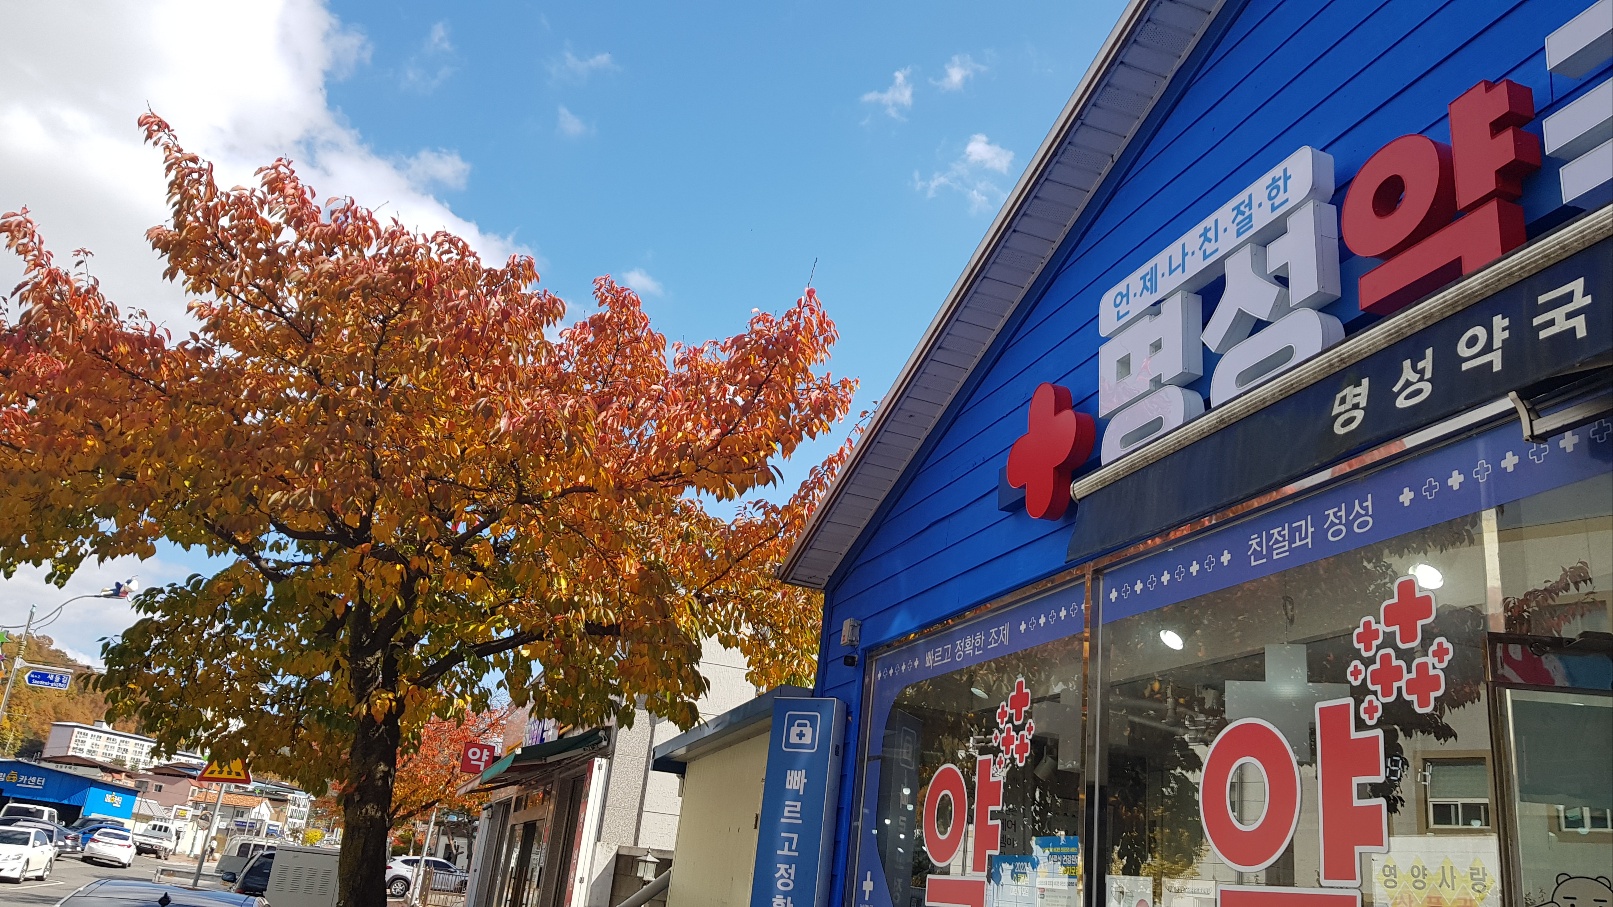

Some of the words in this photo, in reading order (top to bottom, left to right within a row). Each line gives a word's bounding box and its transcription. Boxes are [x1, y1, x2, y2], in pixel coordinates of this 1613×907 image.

[1247, 514, 1315, 567] 친절과
[1323, 493, 1373, 542] 정성
[924, 644, 951, 669] 빠르고
[954, 630, 985, 662] 정확한
[987, 622, 1010, 649] 조제
[467, 747, 490, 771] 약
[17, 775, 46, 786] 카센터
[1381, 864, 1488, 893] 영양사랑
